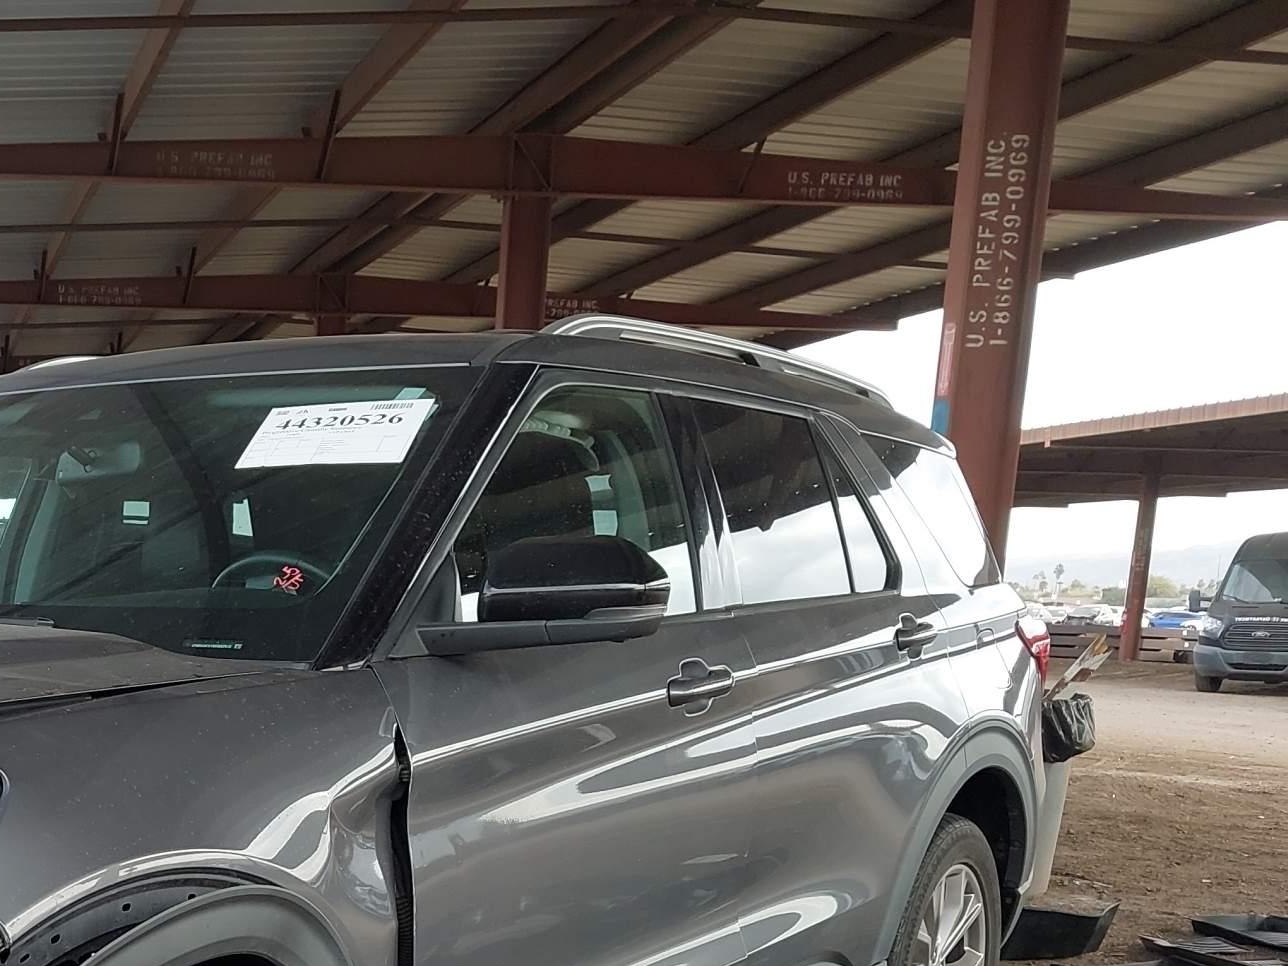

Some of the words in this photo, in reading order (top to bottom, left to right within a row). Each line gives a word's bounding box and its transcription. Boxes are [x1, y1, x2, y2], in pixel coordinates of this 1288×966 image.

[820, 172, 873, 186] PREFAB
[973, 192, 1000, 286] PREFAB
[989, 134, 1030, 345] 1-866-799-0969
[966, 302, 988, 347] U.S.
[275, 412, 404, 431] 44320526
